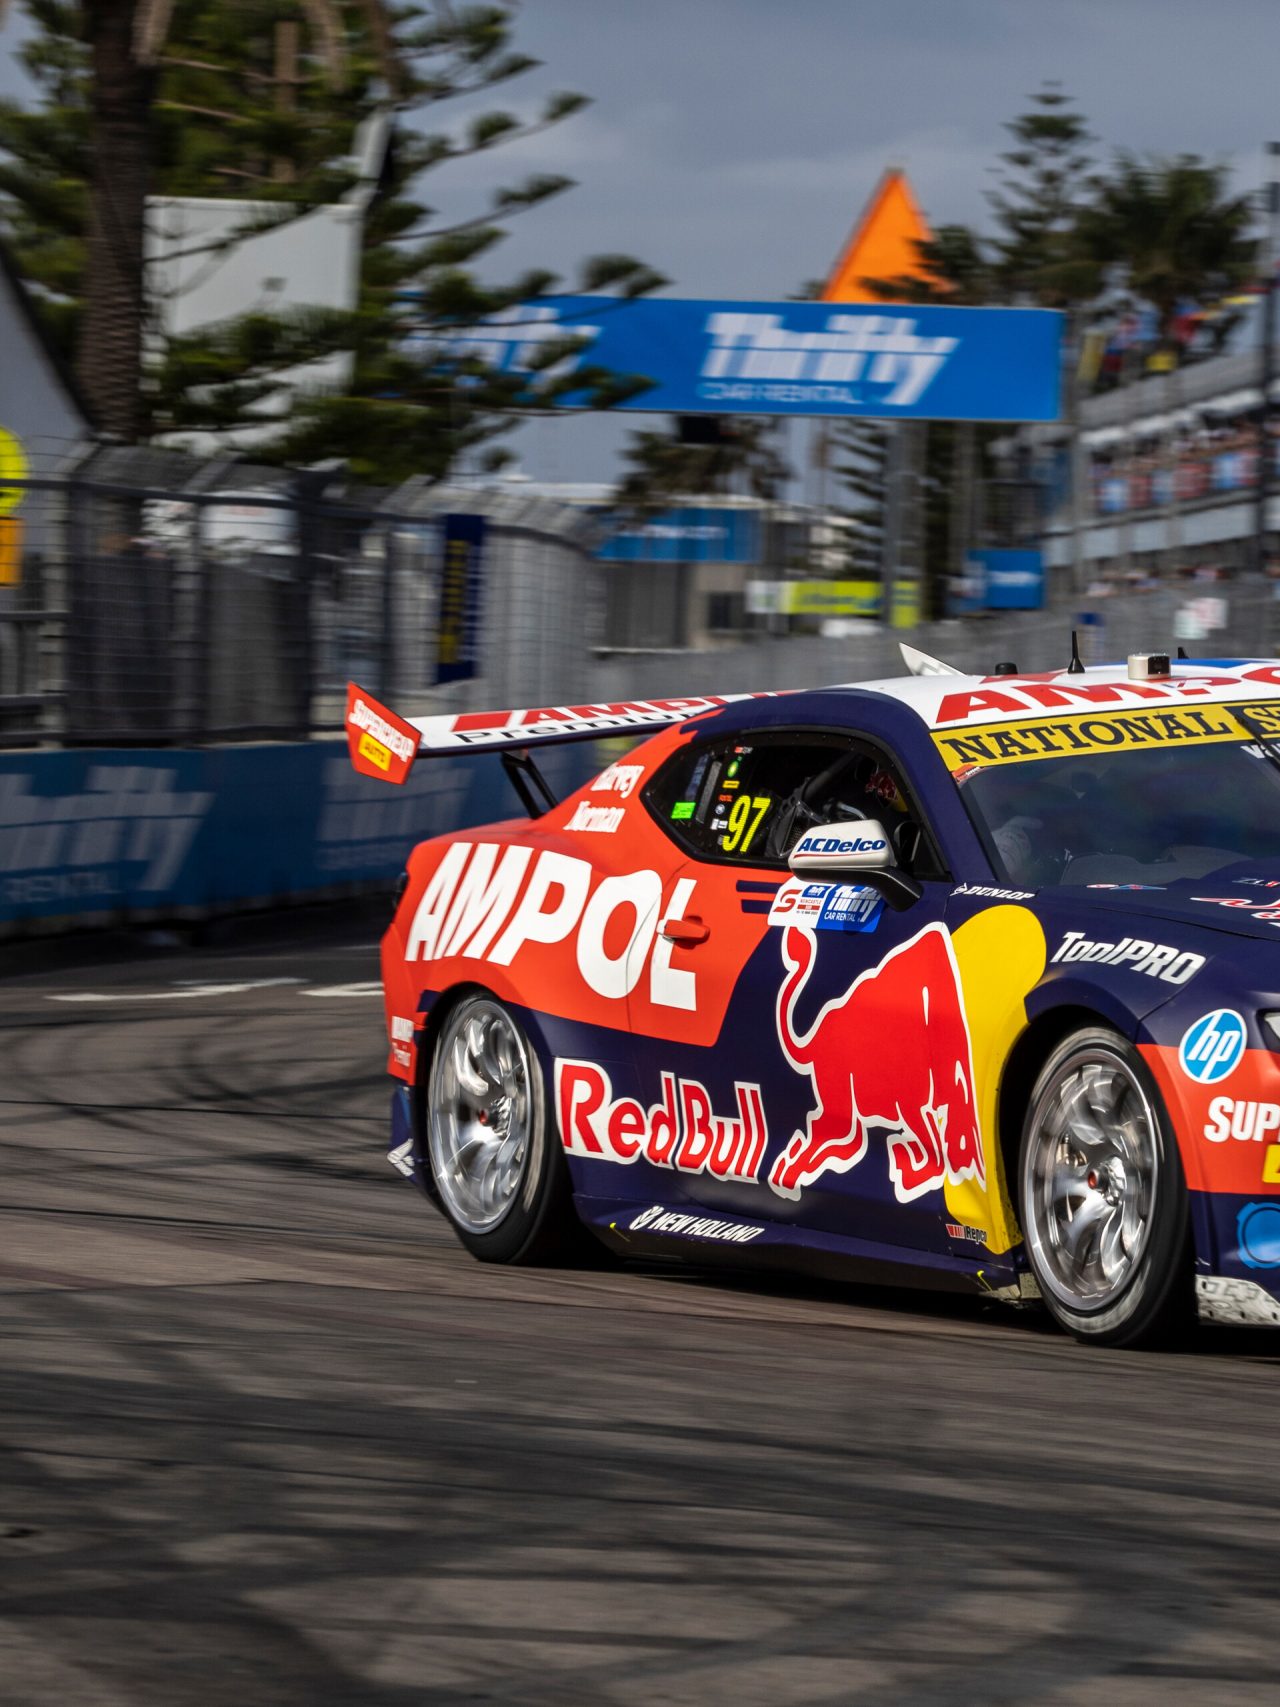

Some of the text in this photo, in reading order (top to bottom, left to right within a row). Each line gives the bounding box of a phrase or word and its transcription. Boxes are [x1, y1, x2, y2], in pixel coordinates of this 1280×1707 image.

[700, 311, 961, 406] Thrifty
[942, 712, 1233, 763] NATIONAL
[722, 795, 771, 854] 97
[796, 837, 887, 853] ACDelco
[824, 911, 837, 920] CAR
[836, 912, 856, 922] RENTAL
[965, 885, 1036, 901] DUNLOP
[404, 842, 698, 1012] AMPOL
[1050, 931, 1207, 985] ToolPRO
[1185, 1012, 1242, 1082] hp
[648, 1212, 766, 1243] NEW HOLLAND
[965, 1225, 988, 1244] Repco
